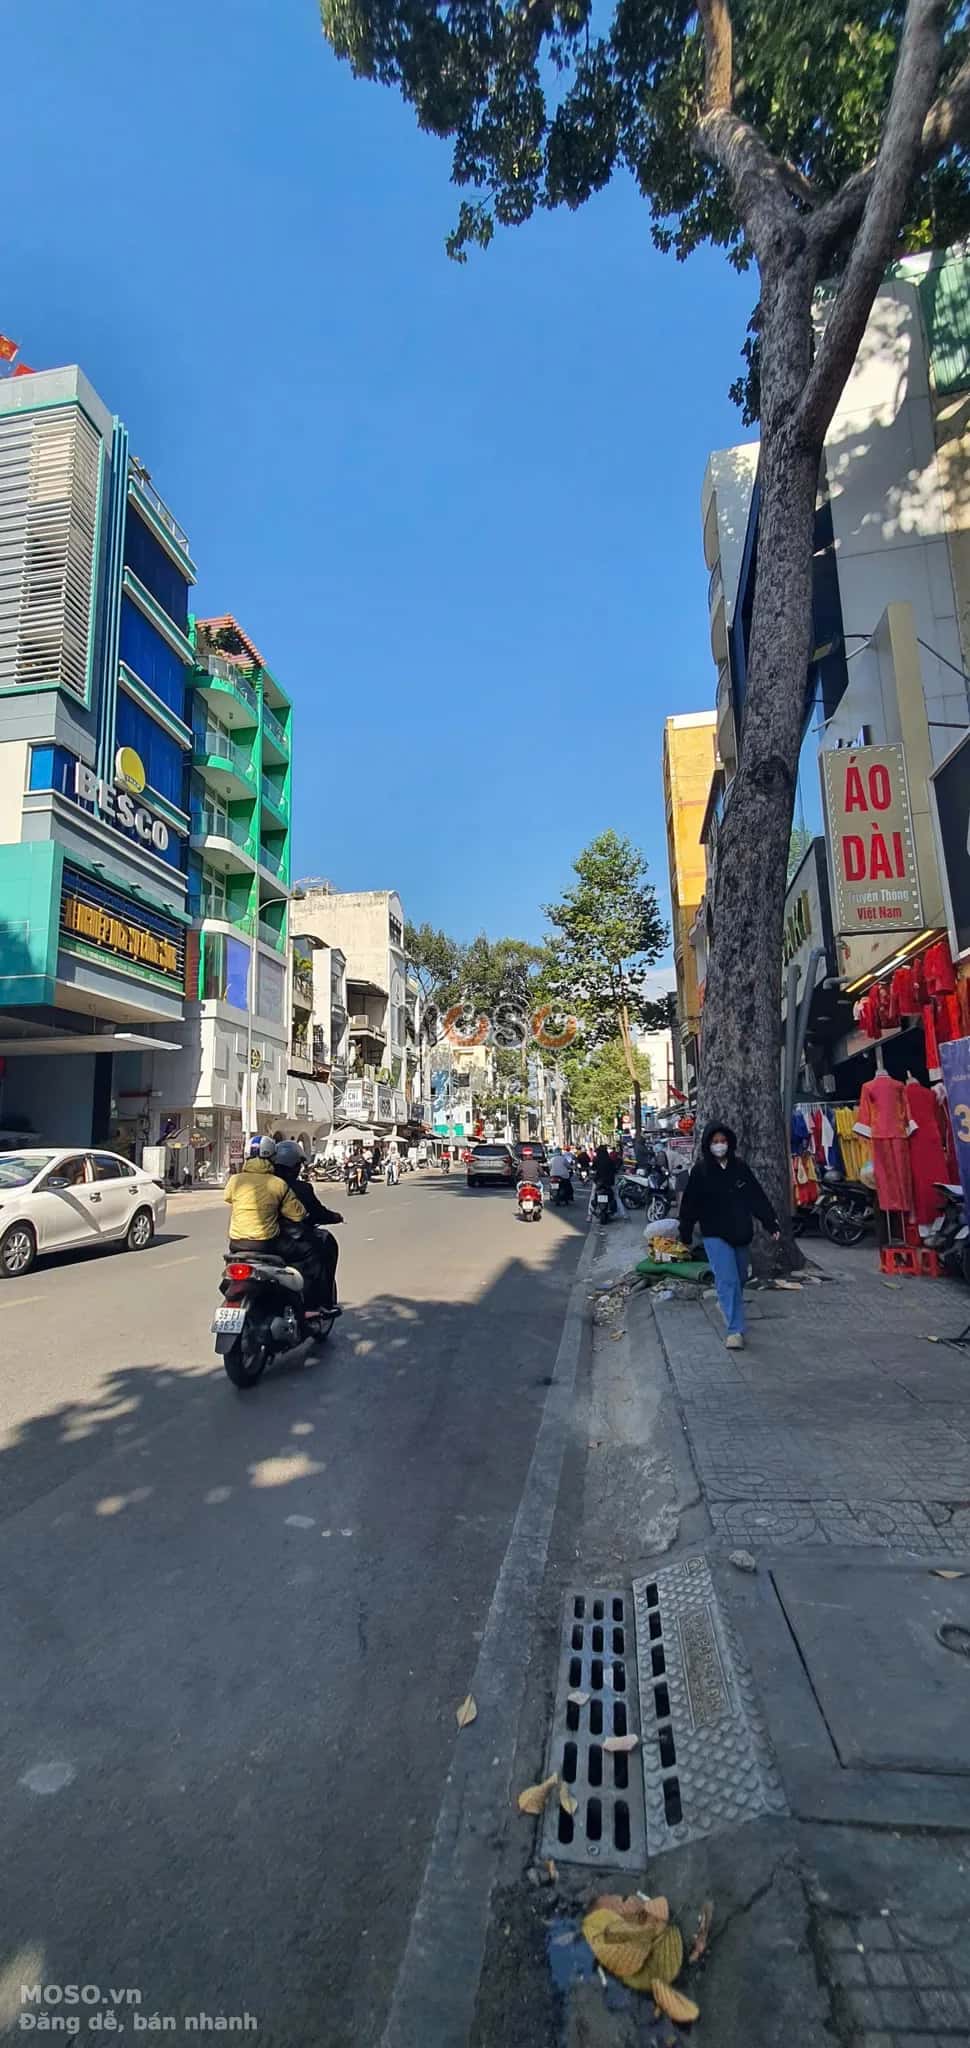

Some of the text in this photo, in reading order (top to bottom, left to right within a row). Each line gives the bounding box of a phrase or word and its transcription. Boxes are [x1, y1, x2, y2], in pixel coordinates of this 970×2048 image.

[75, 762, 169, 851] BESCO
[844, 756, 893, 813] ÁO
[841, 822, 906, 882] DÀI
[857, 905, 902, 922] Việt Nam
